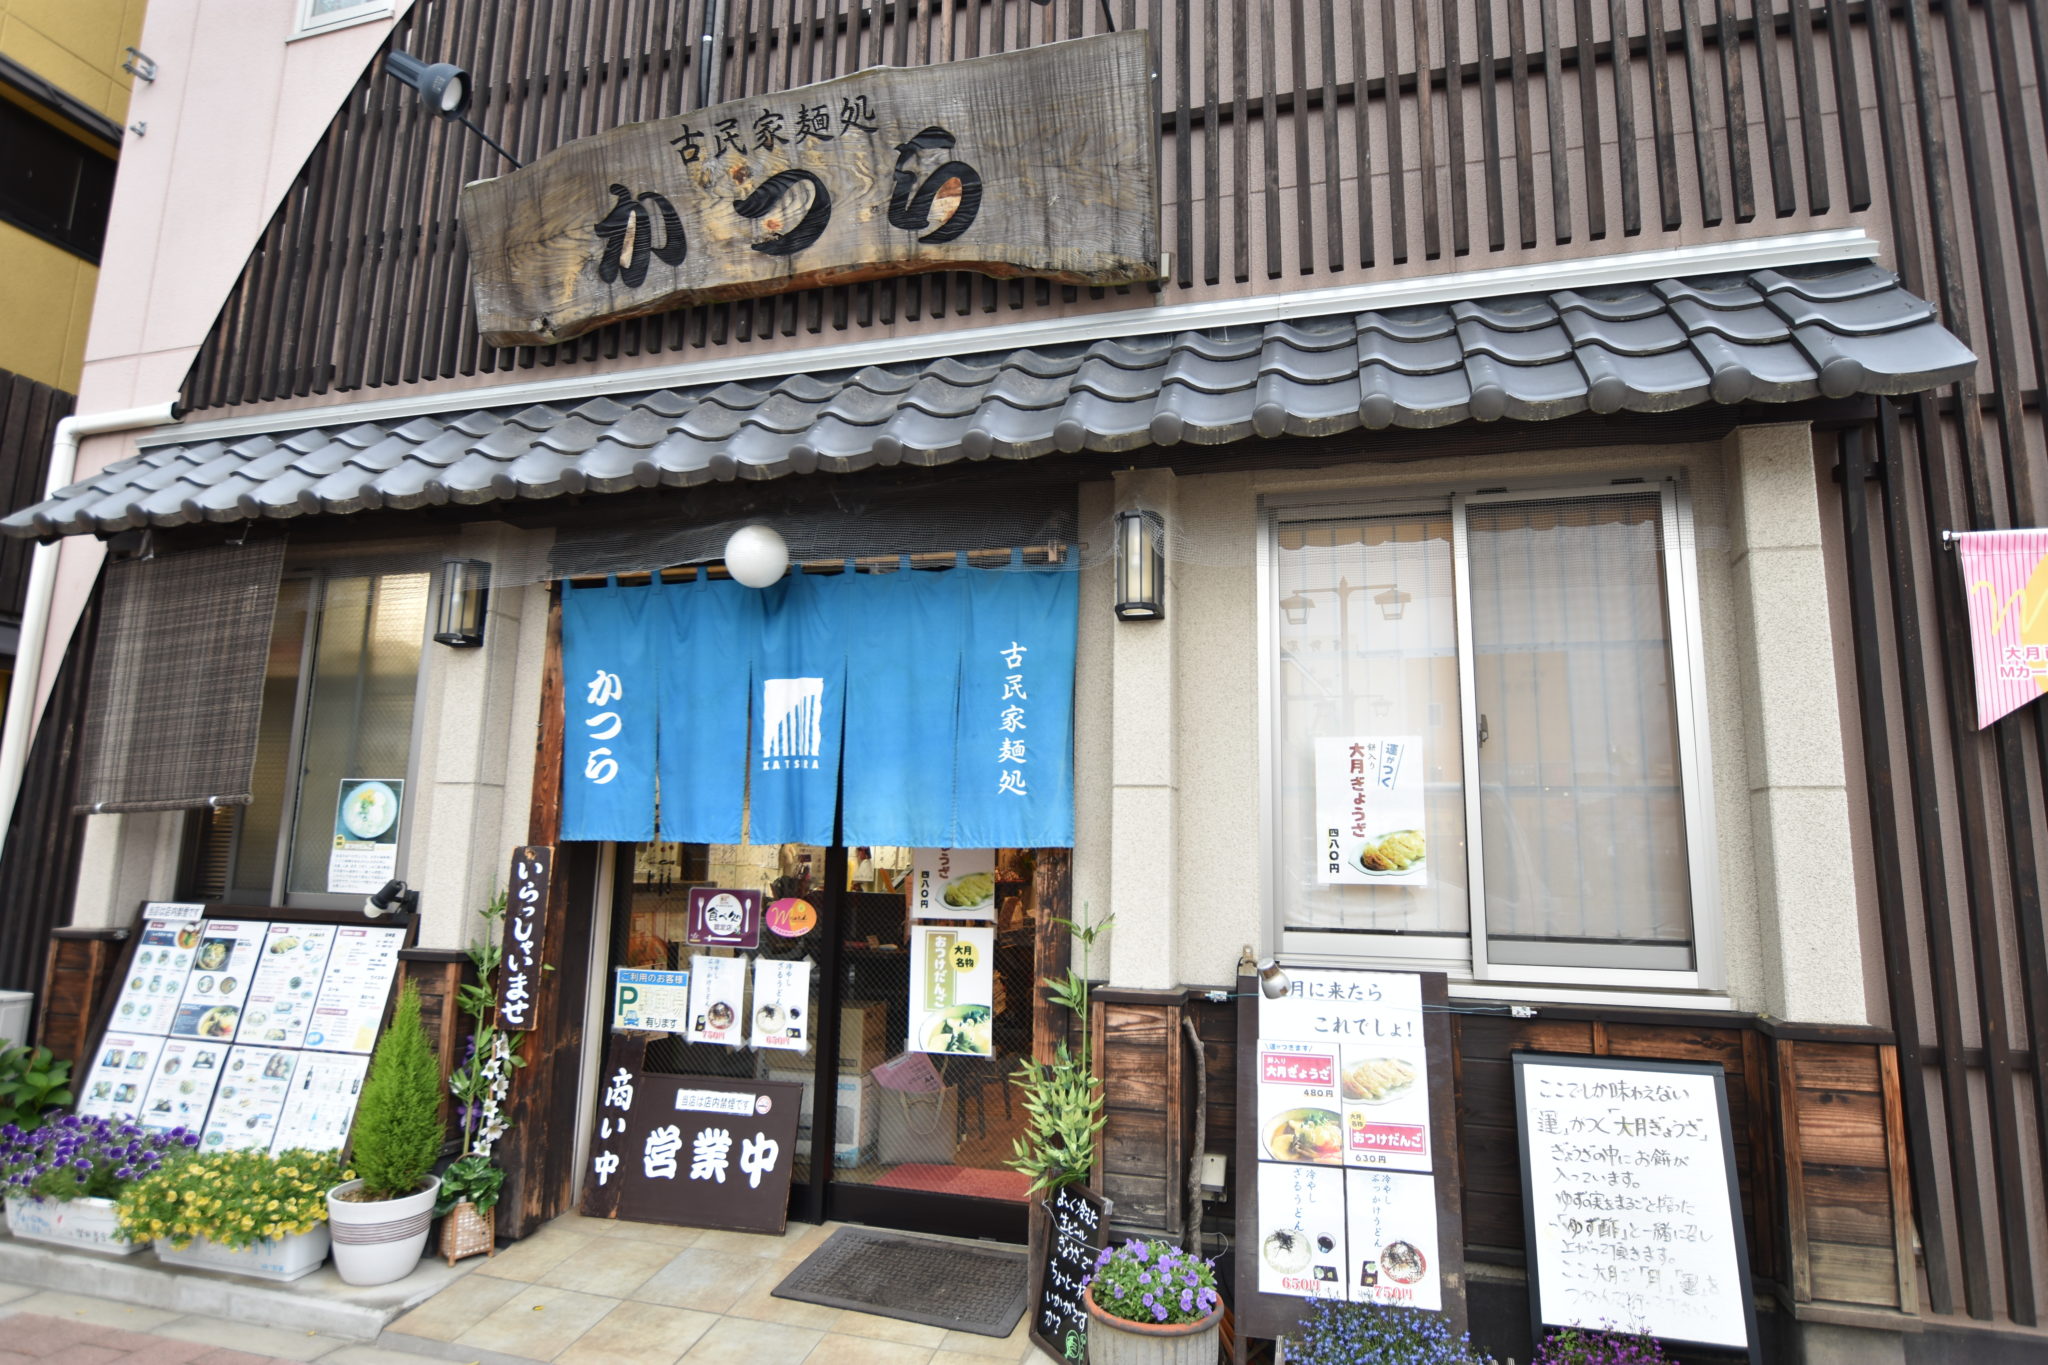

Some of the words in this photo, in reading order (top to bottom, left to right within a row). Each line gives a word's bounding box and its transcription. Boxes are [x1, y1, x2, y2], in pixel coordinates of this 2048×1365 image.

[670, 95, 880, 164] 古民家麺処
[594, 125, 982, 288] かつら
[2005, 647, 2048, 660] 大月
[585, 670, 623, 785] かつら
[997, 641, 1028, 796] 古民家麺処
[1381, 743, 1399, 788] 運がつく
[1349, 743, 1367, 838] 大月ぎょうざ
[707, 907, 742, 922] 食べ処
[500, 861, 543, 1024] いらっしゃいませ
[954, 945, 972, 956] 大月
[933, 936, 951, 1009] おつけだんご
[956, 957, 975, 968] 名物
[621, 972, 684, 985] ご利用のお客様
[1290, 980, 1383, 1001] 月に来たら
[618, 985, 639, 1016] P
[645, 1016, 678, 1028] 有ります
[1266, 1064, 1332, 1081] 大月ぎょうざ
[1304, 1089, 1334, 1098] 480円
[1539, 1079, 1690, 1101] ここでしか味わえない
[594, 1068, 634, 1186] 商い中
[1353, 1131, 1423, 1149] おつけだんご
[643, 1124, 779, 1188] 営業中
[1355, 1154, 1387, 1164] 630円
[1551, 1143, 1690, 1168] ぎょうざの中にお餅が
[1306, 1169, 1316, 1203] 冷やし
[1382, 1174, 1392, 1205] 冷やし
[1060, 1212, 1088, 1241] 生ビール
[1281, 1276, 1321, 1292] 650円
[1374, 1284, 1413, 1300] 750円
